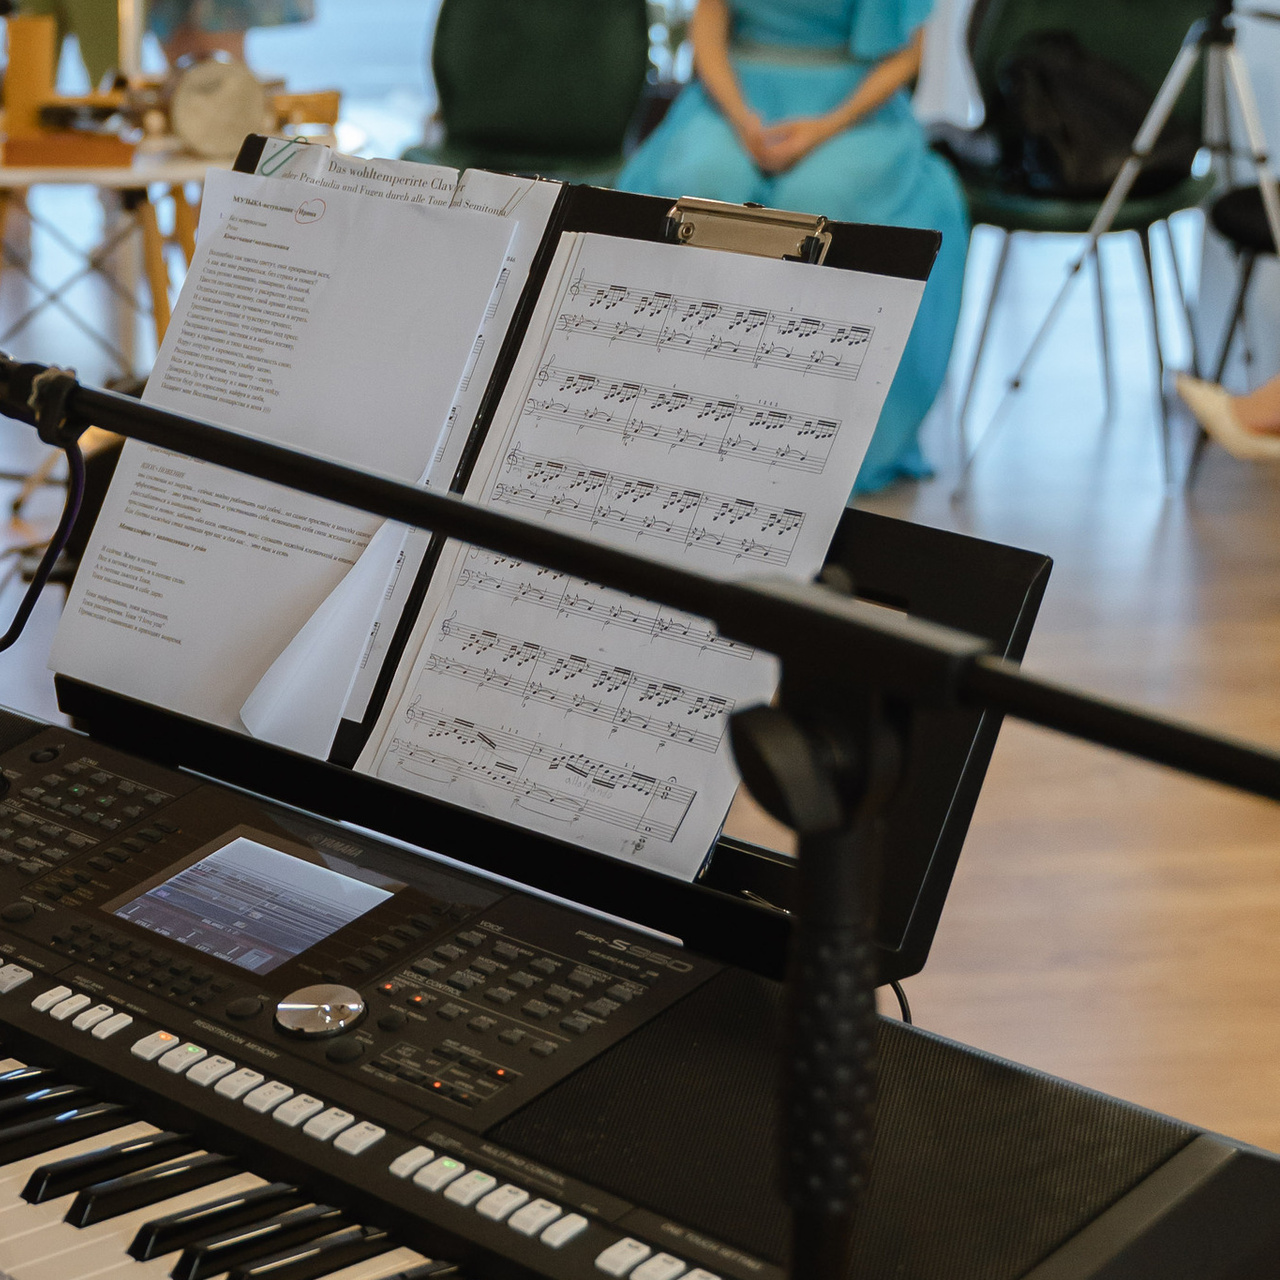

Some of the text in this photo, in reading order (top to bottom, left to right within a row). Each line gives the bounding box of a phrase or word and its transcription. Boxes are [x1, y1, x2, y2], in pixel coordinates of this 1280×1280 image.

[328, 160, 347, 174] Das
[350, 166, 428, 188] wohltemperirte
[300, 172, 340, 190] Praeludia
[342, 183, 358, 194] und
[360, 185, 384, 197] Fugen
[386, 190, 410, 201] durch
[411, 195, 425, 204] alle
[450, 199, 462, 208] nd
[319, 836, 364, 858] YAMAHA
[479, 920, 505, 932] VOICE
[574, 929, 695, 973] PSR-S950
[402, 969, 463, 996] VOICE CONTROL
[193, 1019, 281, 1060] REGISTRATION MEMORY
